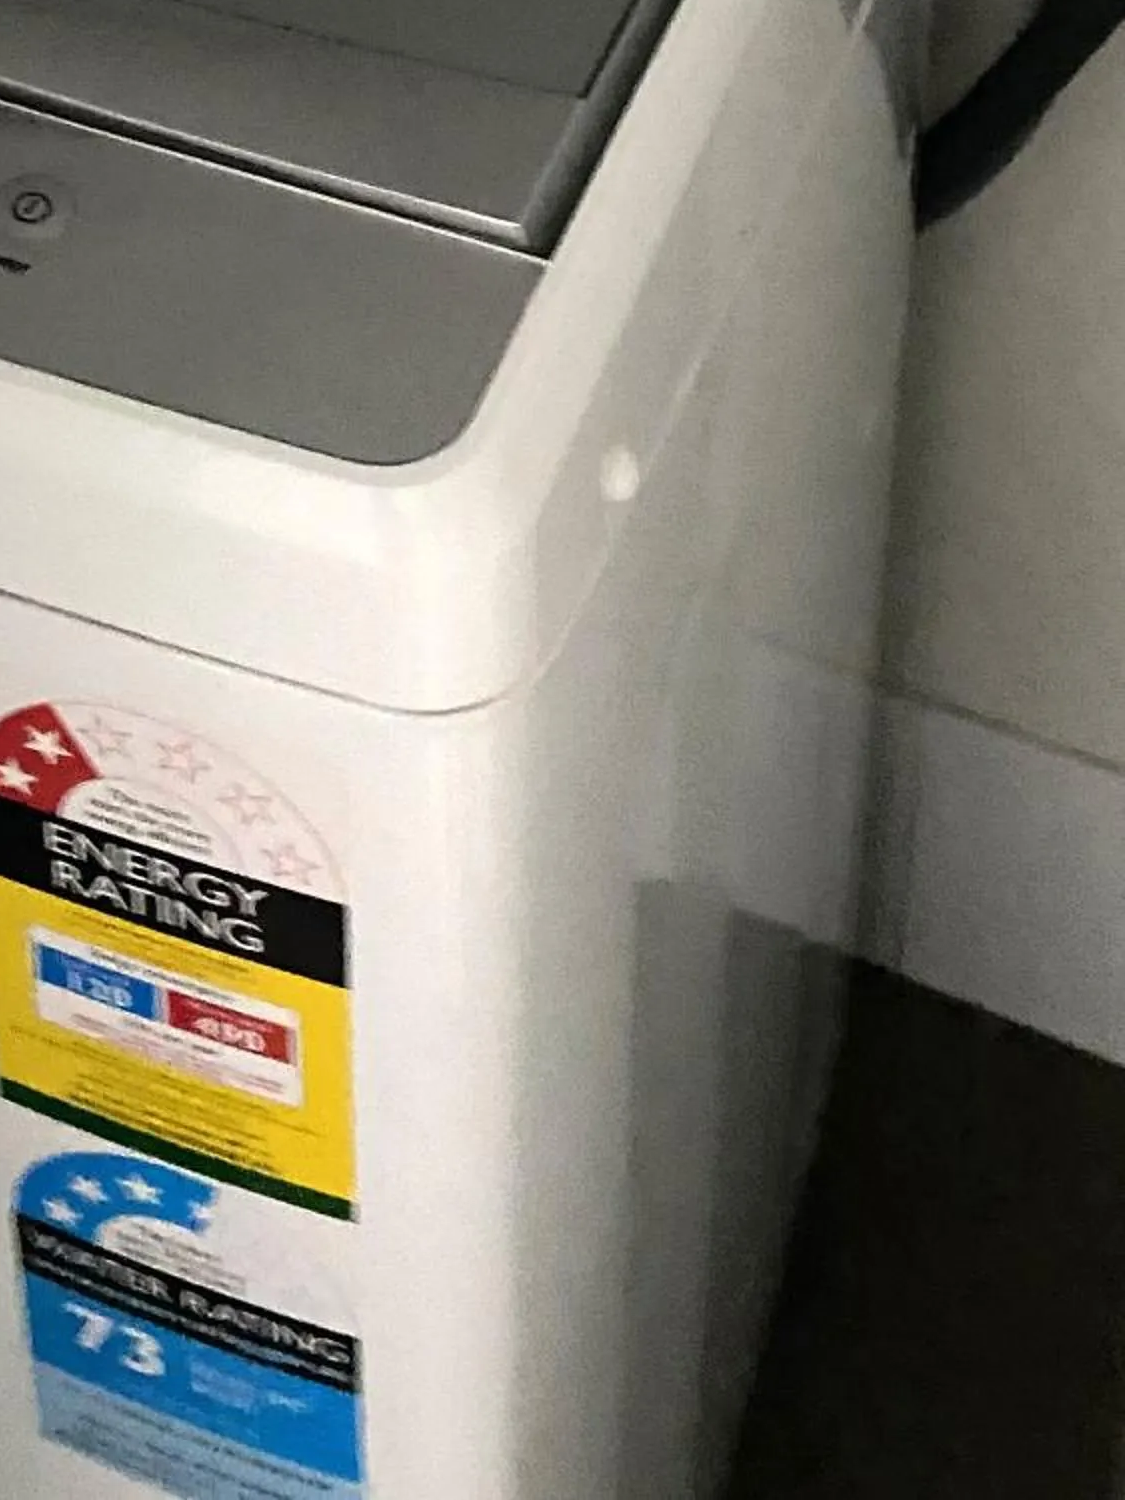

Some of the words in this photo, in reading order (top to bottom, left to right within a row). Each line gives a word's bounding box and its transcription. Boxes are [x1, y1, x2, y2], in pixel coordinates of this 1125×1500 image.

[42, 820, 271, 917] ENERGY
[49, 858, 266, 954] RATING
[177, 1289, 352, 1365] RATING
